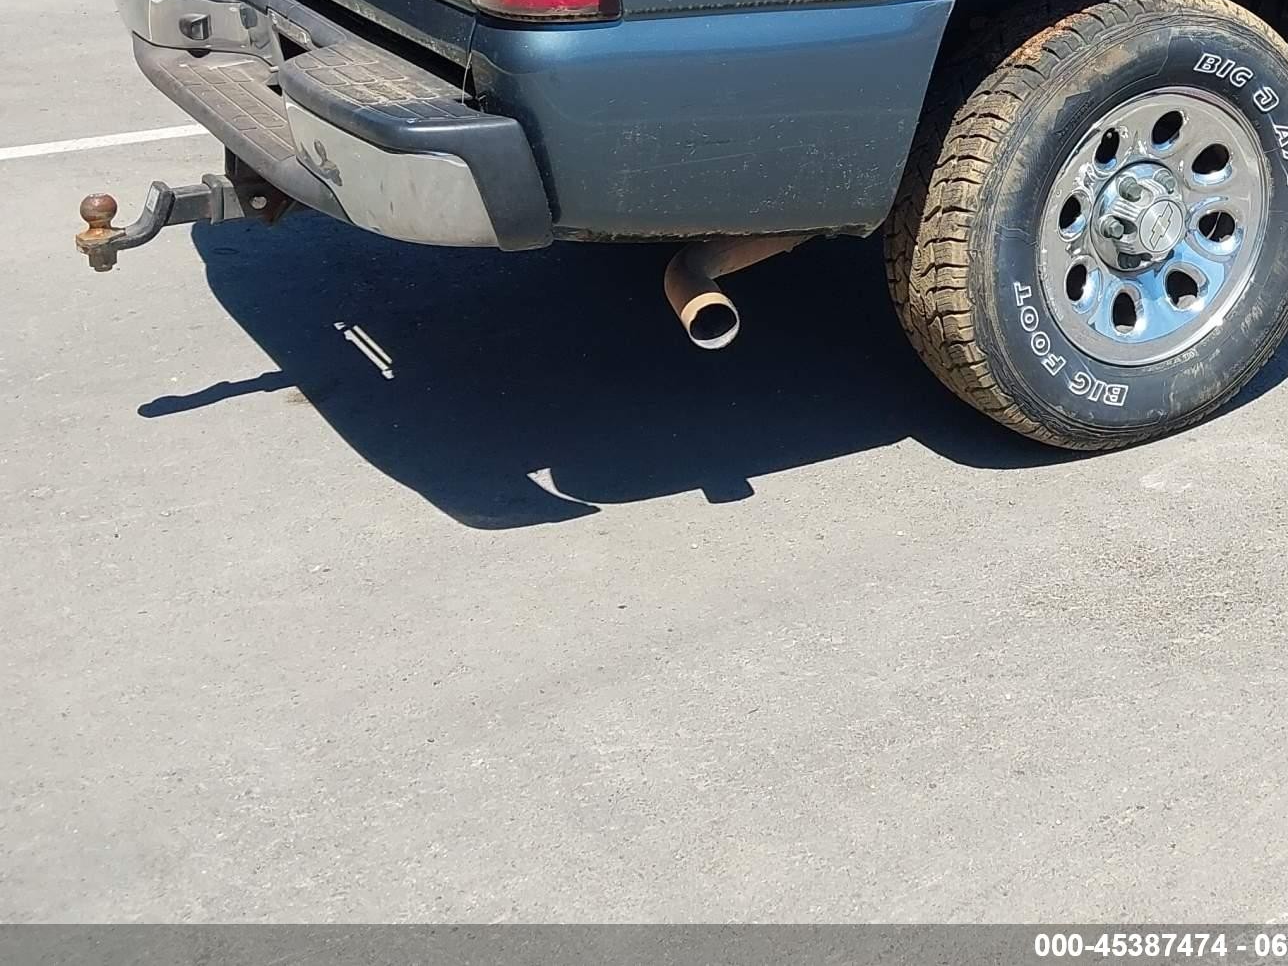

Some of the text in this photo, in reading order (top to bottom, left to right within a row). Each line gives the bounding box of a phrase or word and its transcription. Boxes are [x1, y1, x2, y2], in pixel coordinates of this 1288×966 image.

[1193, 53, 1254, 88] BIG
[1013, 281, 1129, 407] BIG FOOT
